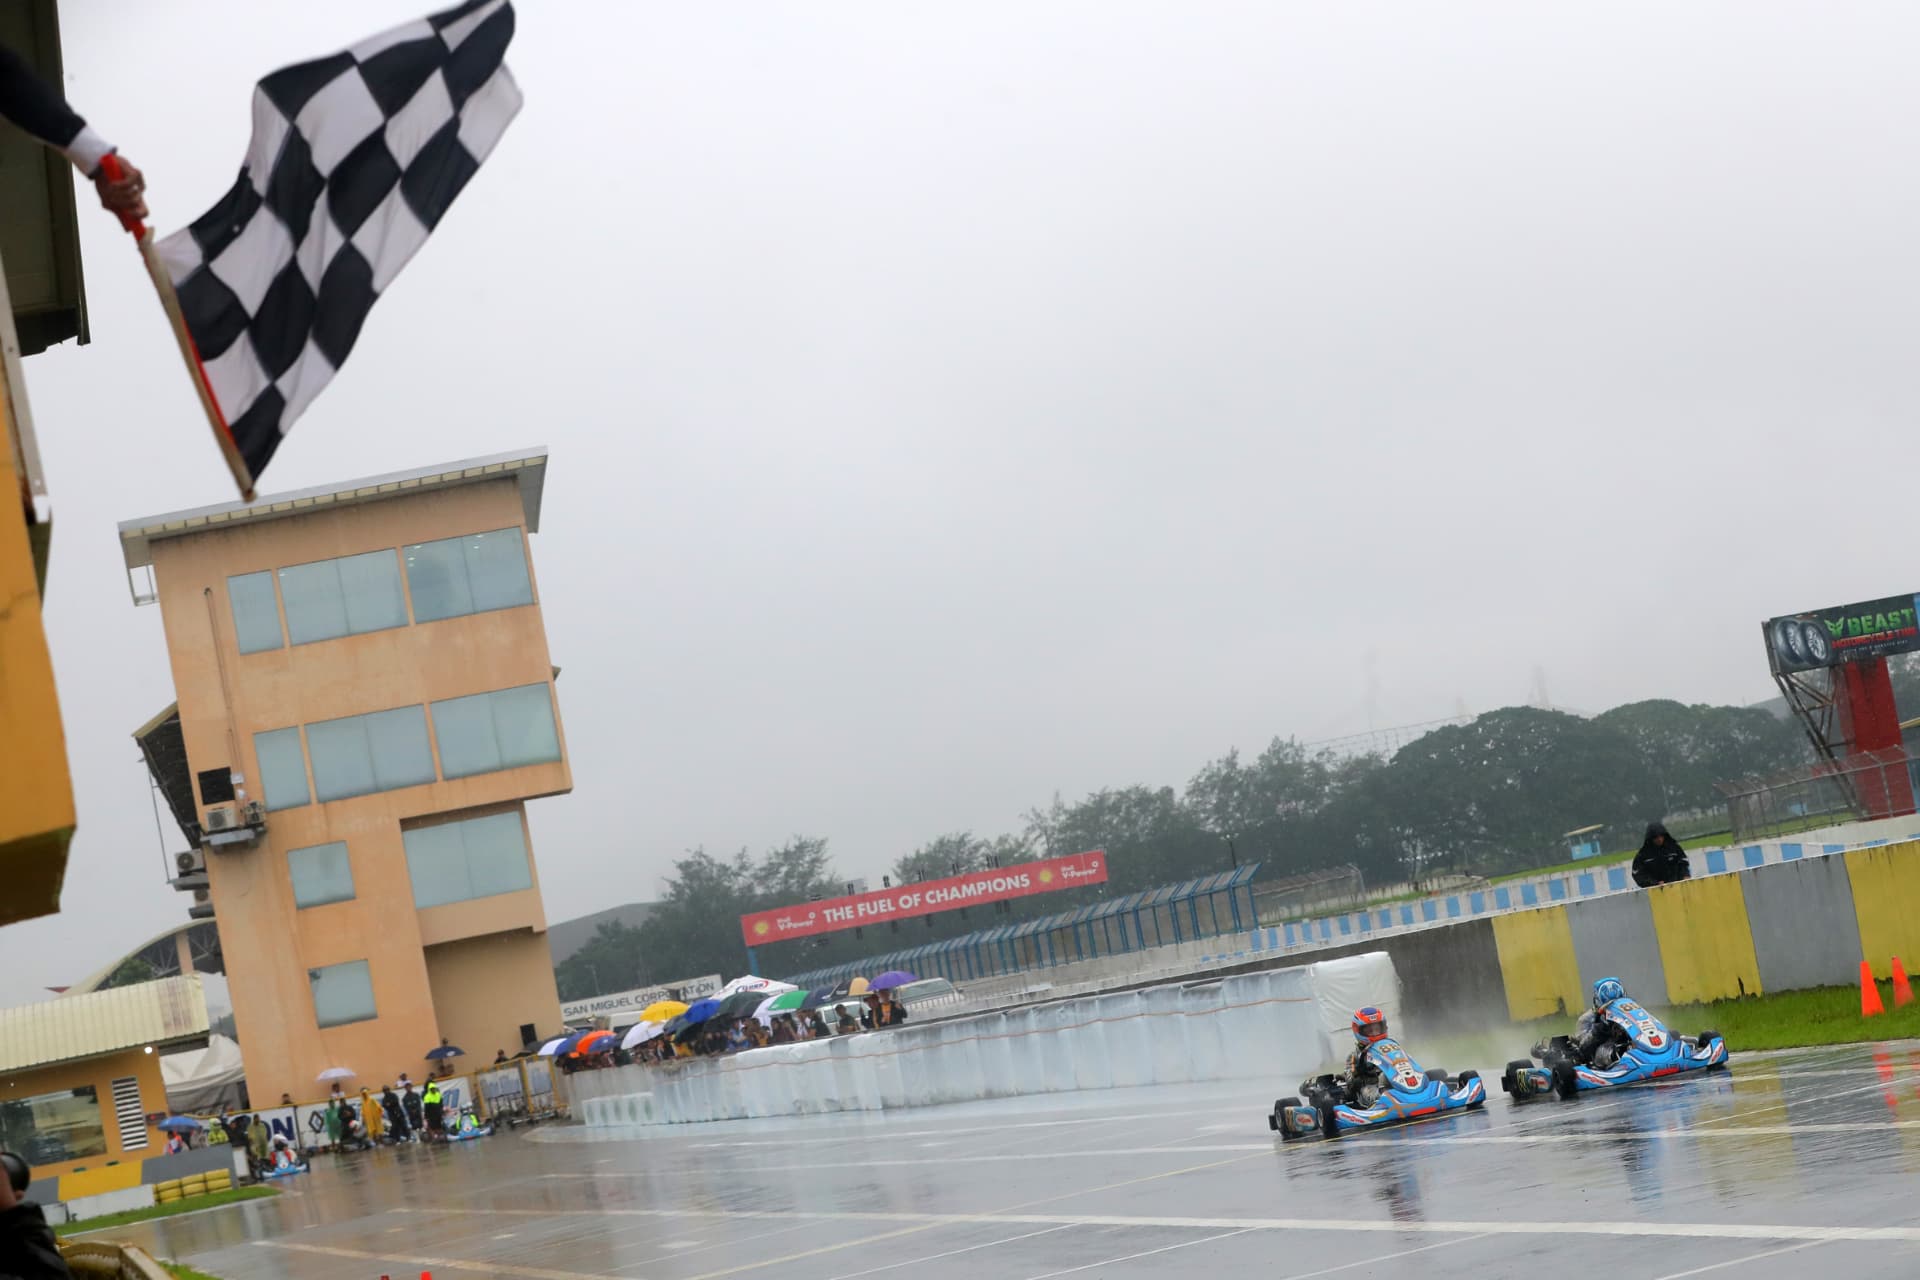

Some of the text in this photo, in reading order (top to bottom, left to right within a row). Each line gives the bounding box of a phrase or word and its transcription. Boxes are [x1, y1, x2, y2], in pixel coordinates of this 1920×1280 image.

[1847, 607, 1914, 636] BEAST
[823, 874, 1031, 924] THE FUEL OF CHAMPIONS
[563, 1005, 588, 1017] SAN
[590, 998, 632, 1012] MIGUEL
[634, 981, 715, 1004] CORPOATION
